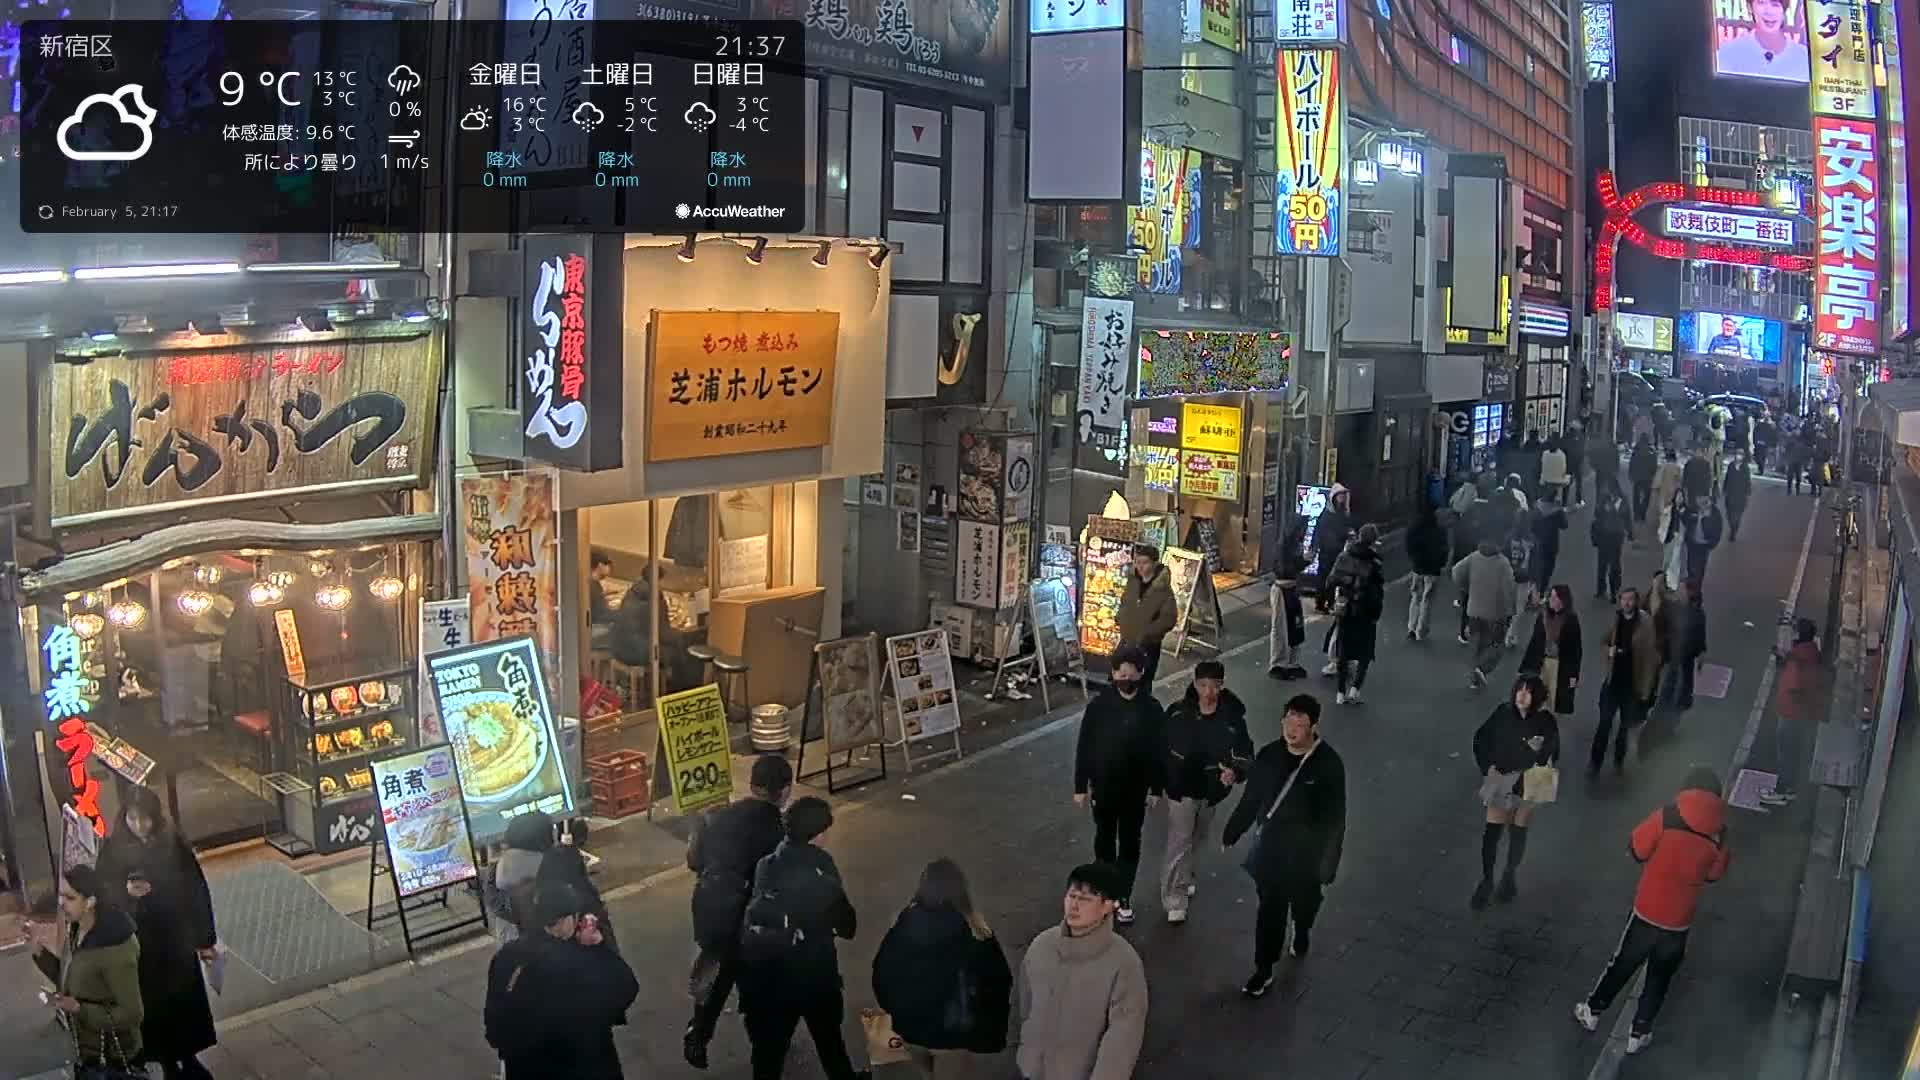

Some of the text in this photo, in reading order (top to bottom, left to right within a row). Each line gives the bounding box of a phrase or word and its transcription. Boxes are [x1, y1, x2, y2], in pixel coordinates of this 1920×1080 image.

[1832, 97, 1856, 111] 3F
[1297, 55, 1320, 188] ハイボール
[1289, 195, 1327, 221] 50
[1134, 219, 1157, 250] 50
[1295, 223, 1319, 249] 円
[1670, 210, 1789, 242] 歌舞伎町一番街
[1819, 126, 1877, 330] 安楽亭
[561, 253, 585, 400] 東京豚骨
[1817, 331, 1837, 347] 2F
[703, 331, 799, 354] もつ焼 煮込み
[668, 365, 823, 405] 芝浦ホルモン
[44, 625, 90, 721] 角煮
[436, 663, 480, 682] TOKYO
[501, 655, 540, 719] 角煮
[675, 726, 719, 748] ハイボール
[381, 768, 428, 800] 角煮
